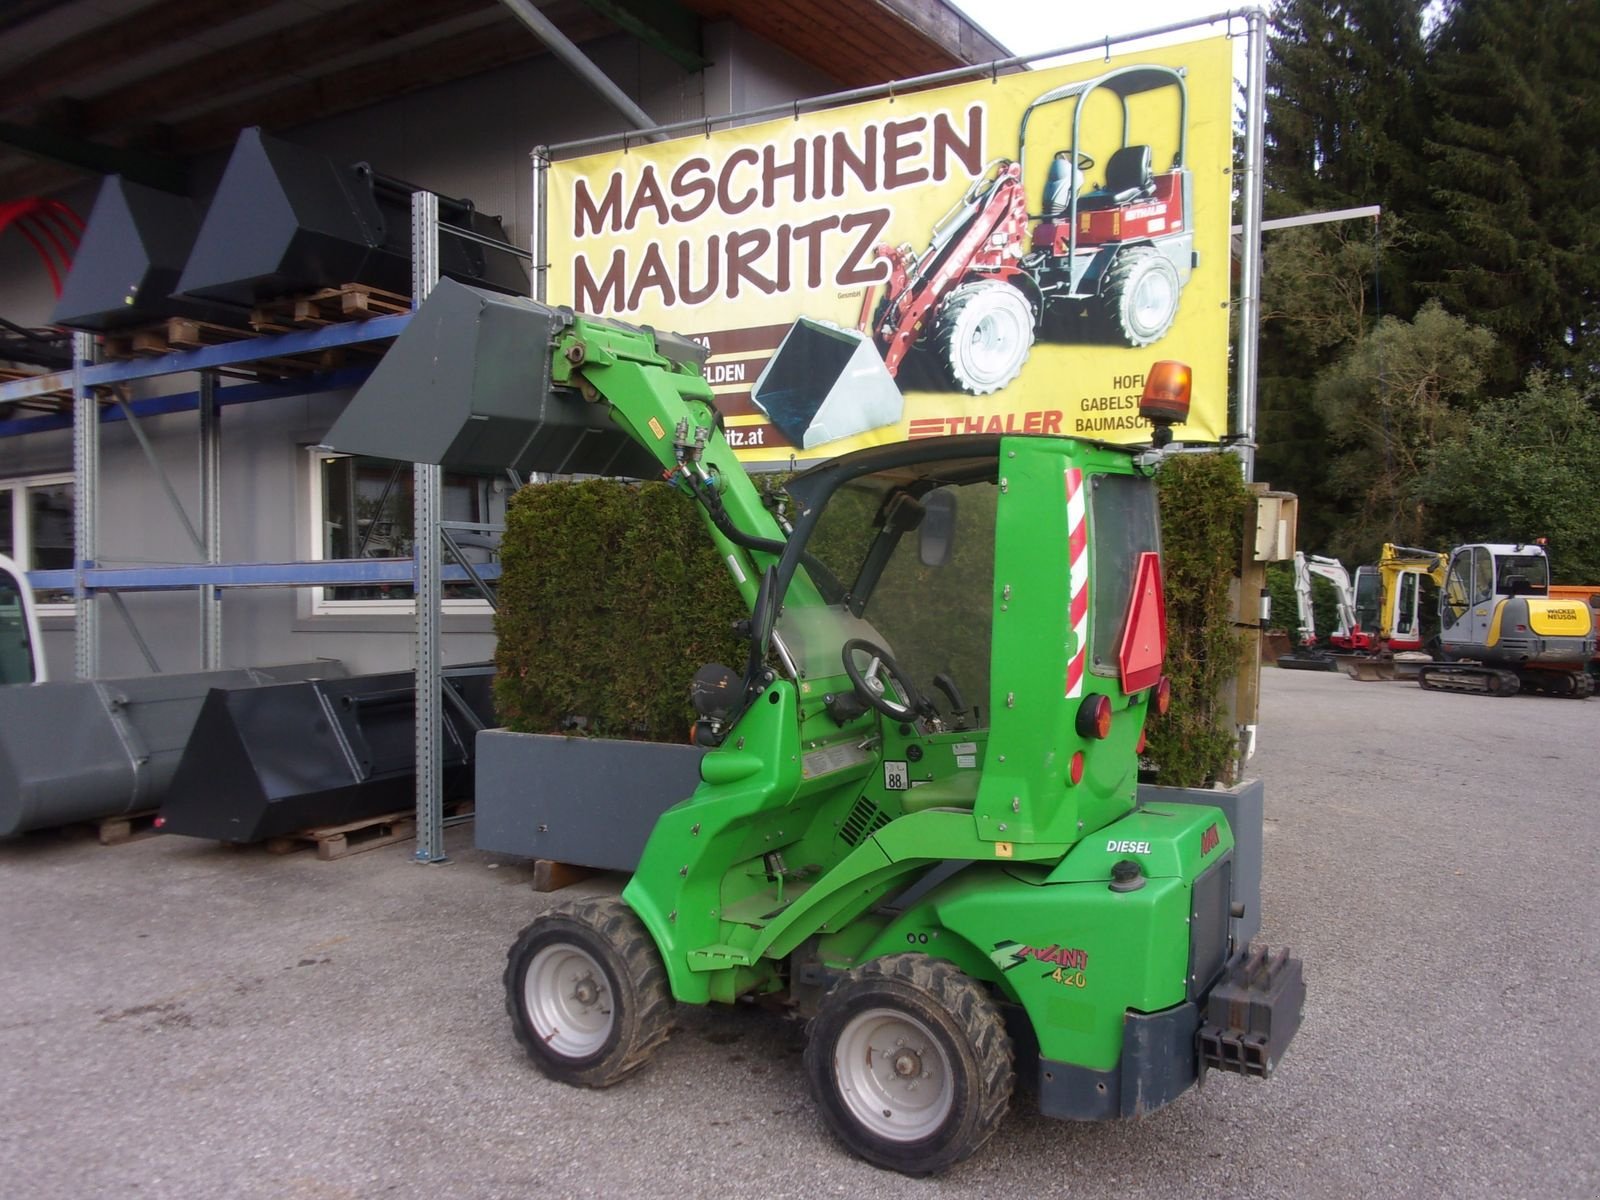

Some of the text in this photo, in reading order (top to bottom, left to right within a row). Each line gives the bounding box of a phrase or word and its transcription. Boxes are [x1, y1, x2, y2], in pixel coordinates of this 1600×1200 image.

[574, 105, 983, 238] MASCHINEN
[574, 208, 891, 315] MAURITZ
[945, 410, 1064, 434] THALER
[889, 773, 902, 788] 88
[1106, 840, 1151, 854] DIESEL
[1015, 944, 1088, 971] AVANT
[1051, 967, 1087, 989] 420
